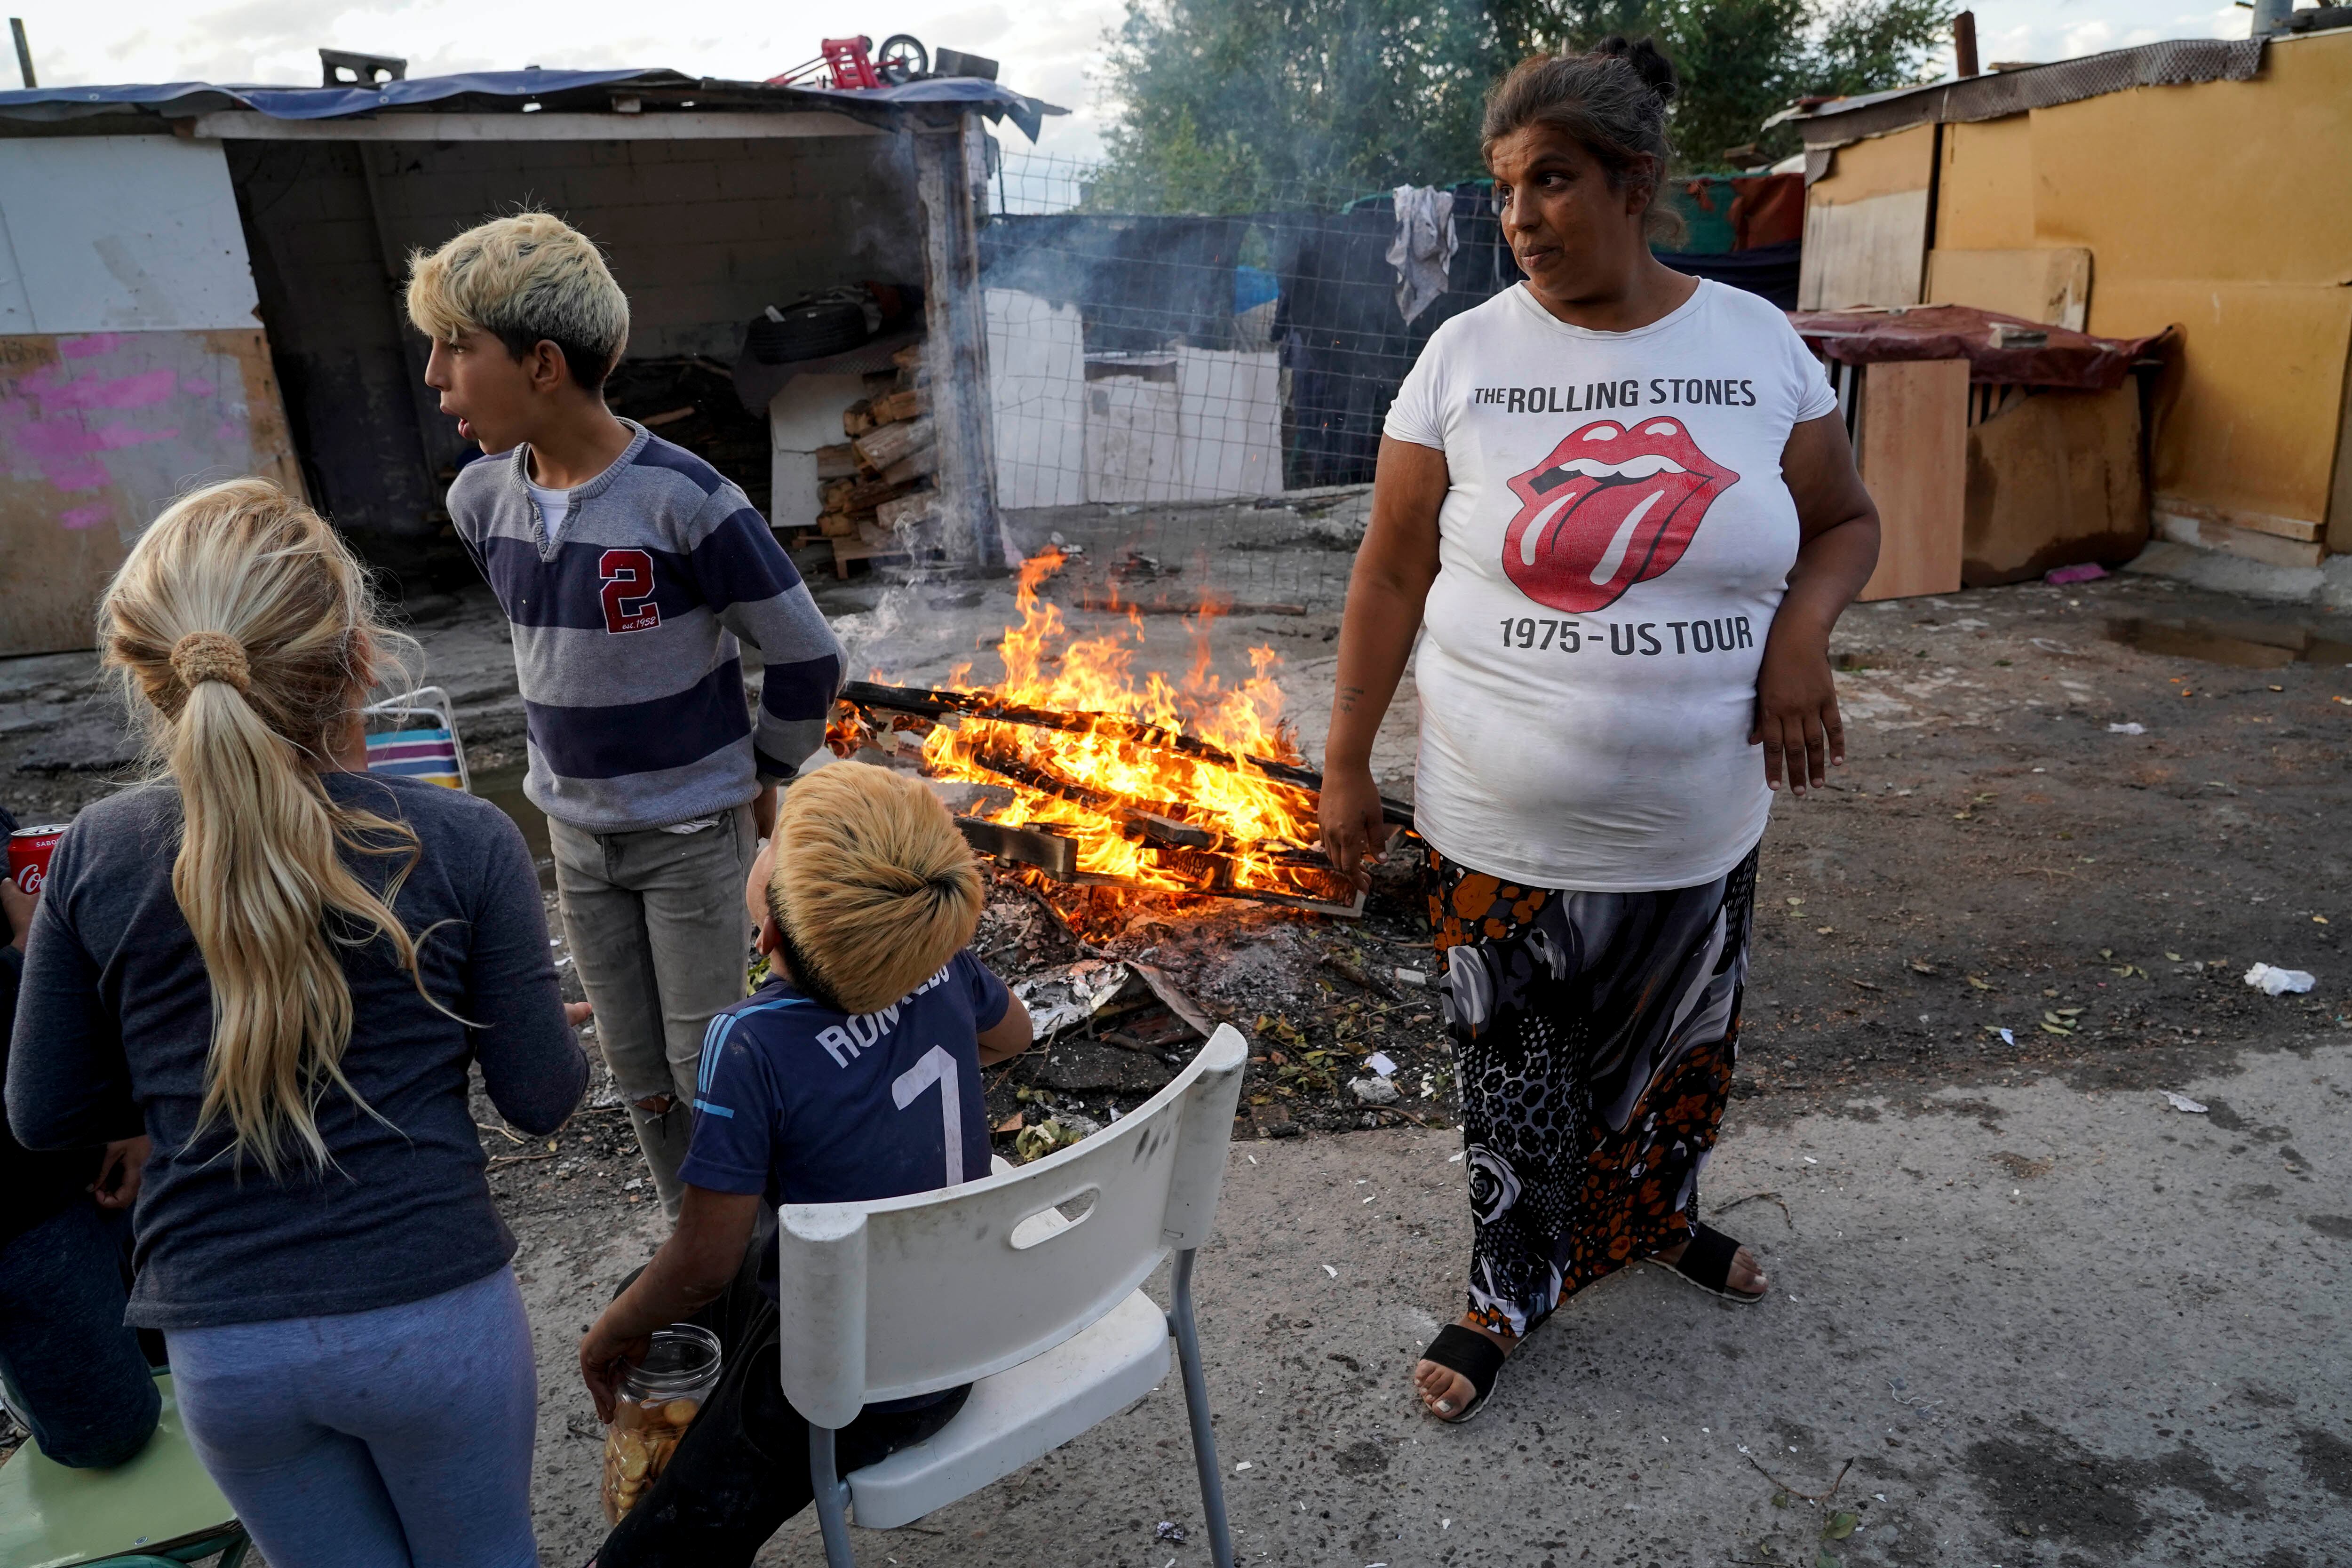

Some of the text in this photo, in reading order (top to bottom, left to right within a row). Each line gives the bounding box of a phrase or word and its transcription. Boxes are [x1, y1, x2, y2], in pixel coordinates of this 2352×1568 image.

[1475, 379, 1756, 413] THE ROLLING STONES
[599, 549, 661, 634] 2
[1666, 616, 1753, 654] TOUR
[36, 839, 59, 847] SABO
[892, 1045, 963, 1187] 7
